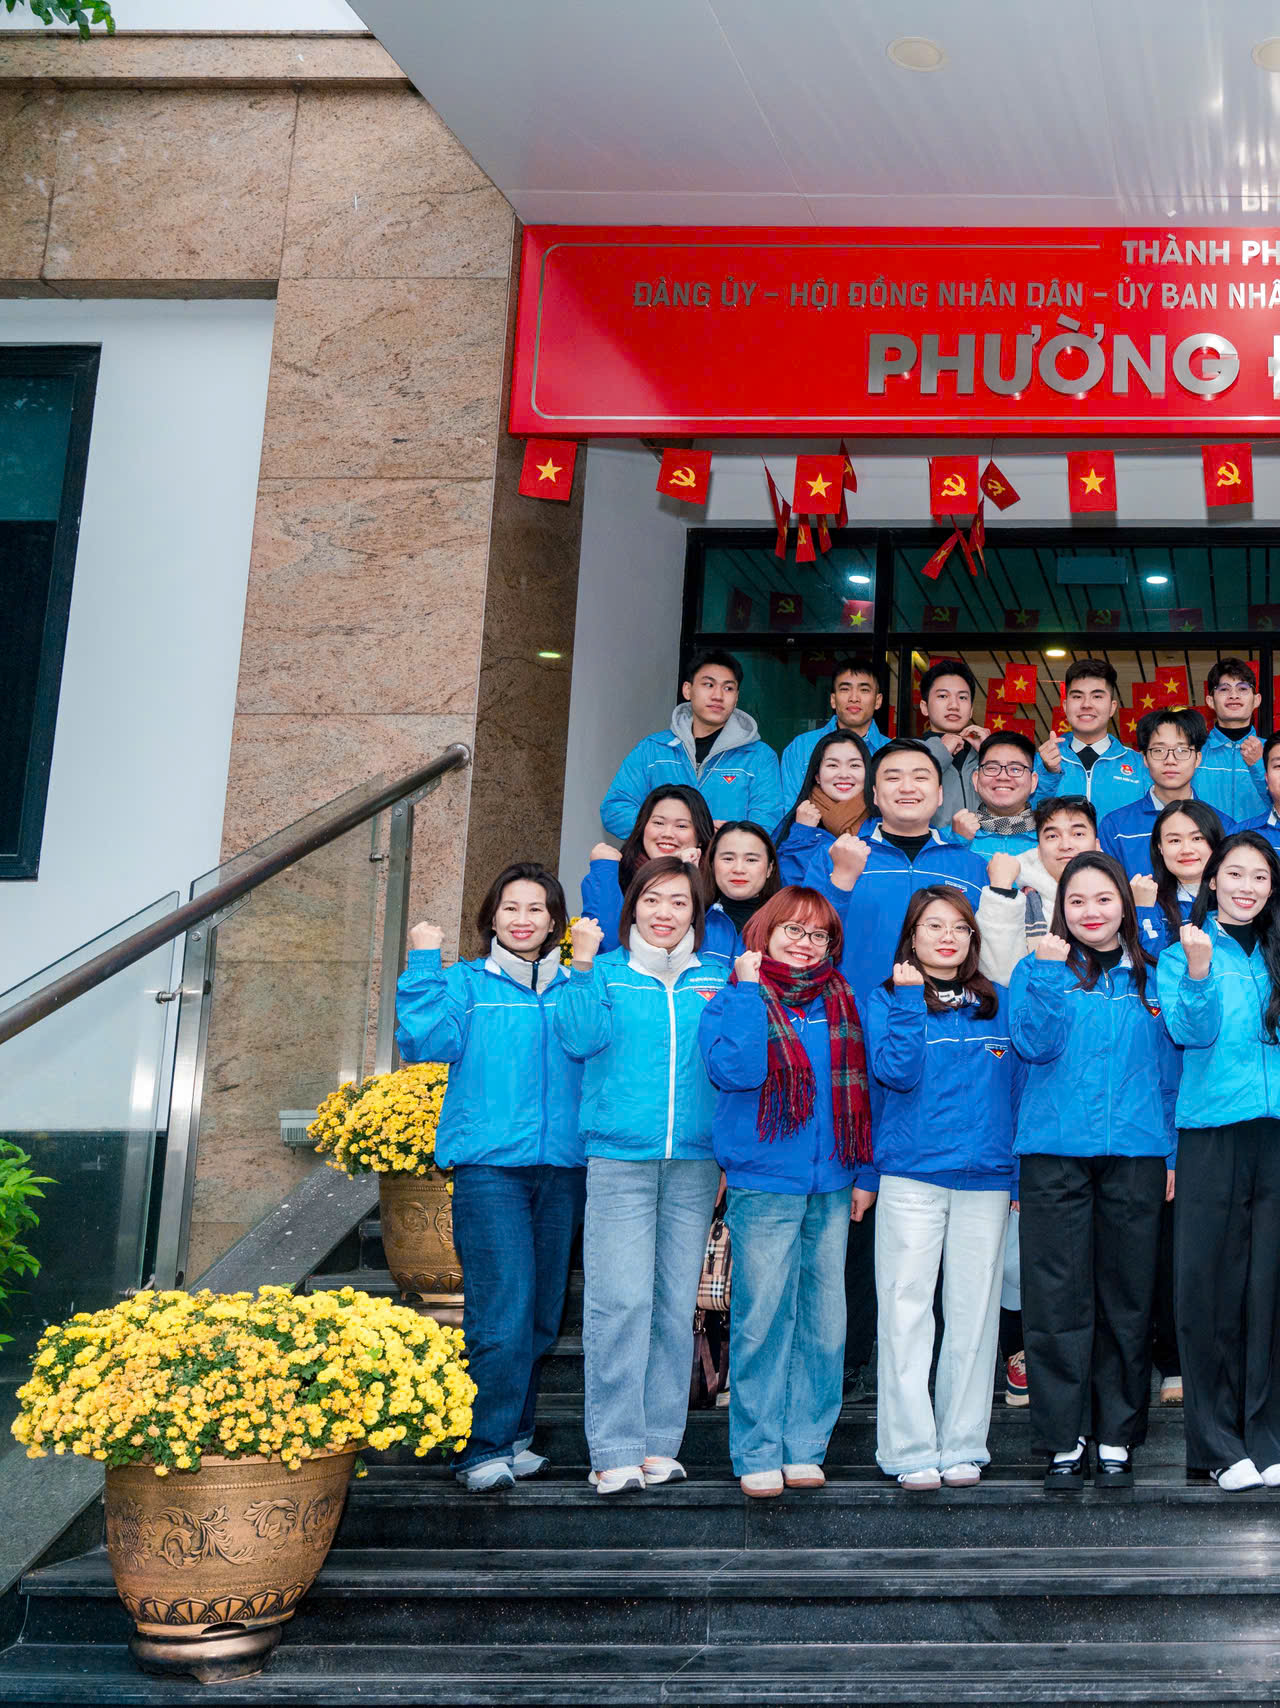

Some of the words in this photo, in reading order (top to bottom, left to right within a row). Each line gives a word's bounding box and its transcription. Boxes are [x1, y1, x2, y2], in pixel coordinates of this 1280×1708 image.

[1122, 233, 1230, 266] THÀNH
[633, 276, 711, 308] ĐẢNG
[721, 275, 757, 308] ỦY
[790, 278, 837, 311] HỘI
[848, 275, 928, 308] ĐỒNG
[938, 278, 1015, 308] NHÂN
[1027, 278, 1082, 308] DÂN
[1118, 277, 1153, 309] ỦY
[1161, 283, 1217, 309] BAN
[867, 314, 1240, 395] PHƯỜNG
